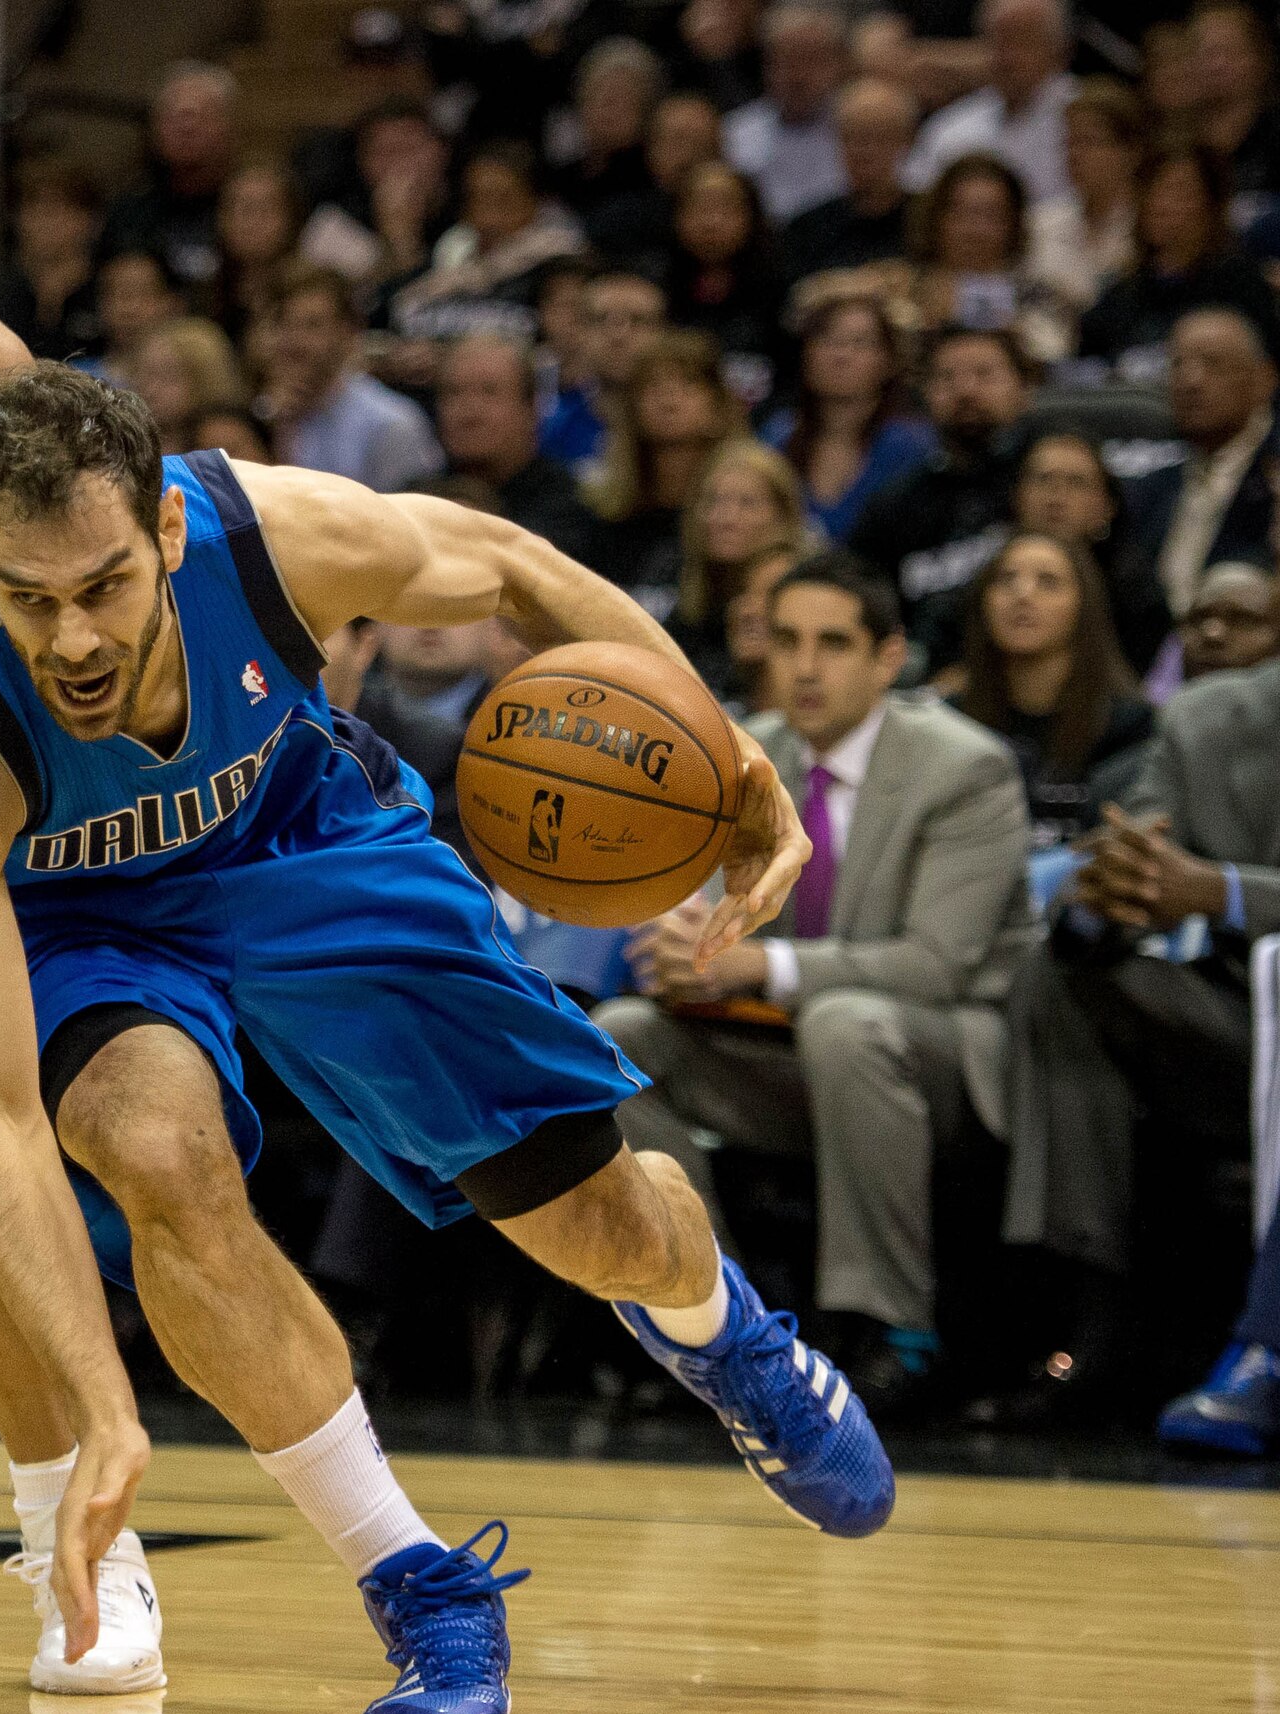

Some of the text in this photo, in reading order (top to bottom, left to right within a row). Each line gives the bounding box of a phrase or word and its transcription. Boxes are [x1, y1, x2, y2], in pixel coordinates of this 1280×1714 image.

[250, 693, 265, 706] NBA
[487, 702, 674, 785] SPALDING
[26, 708, 292, 871] DALLA
